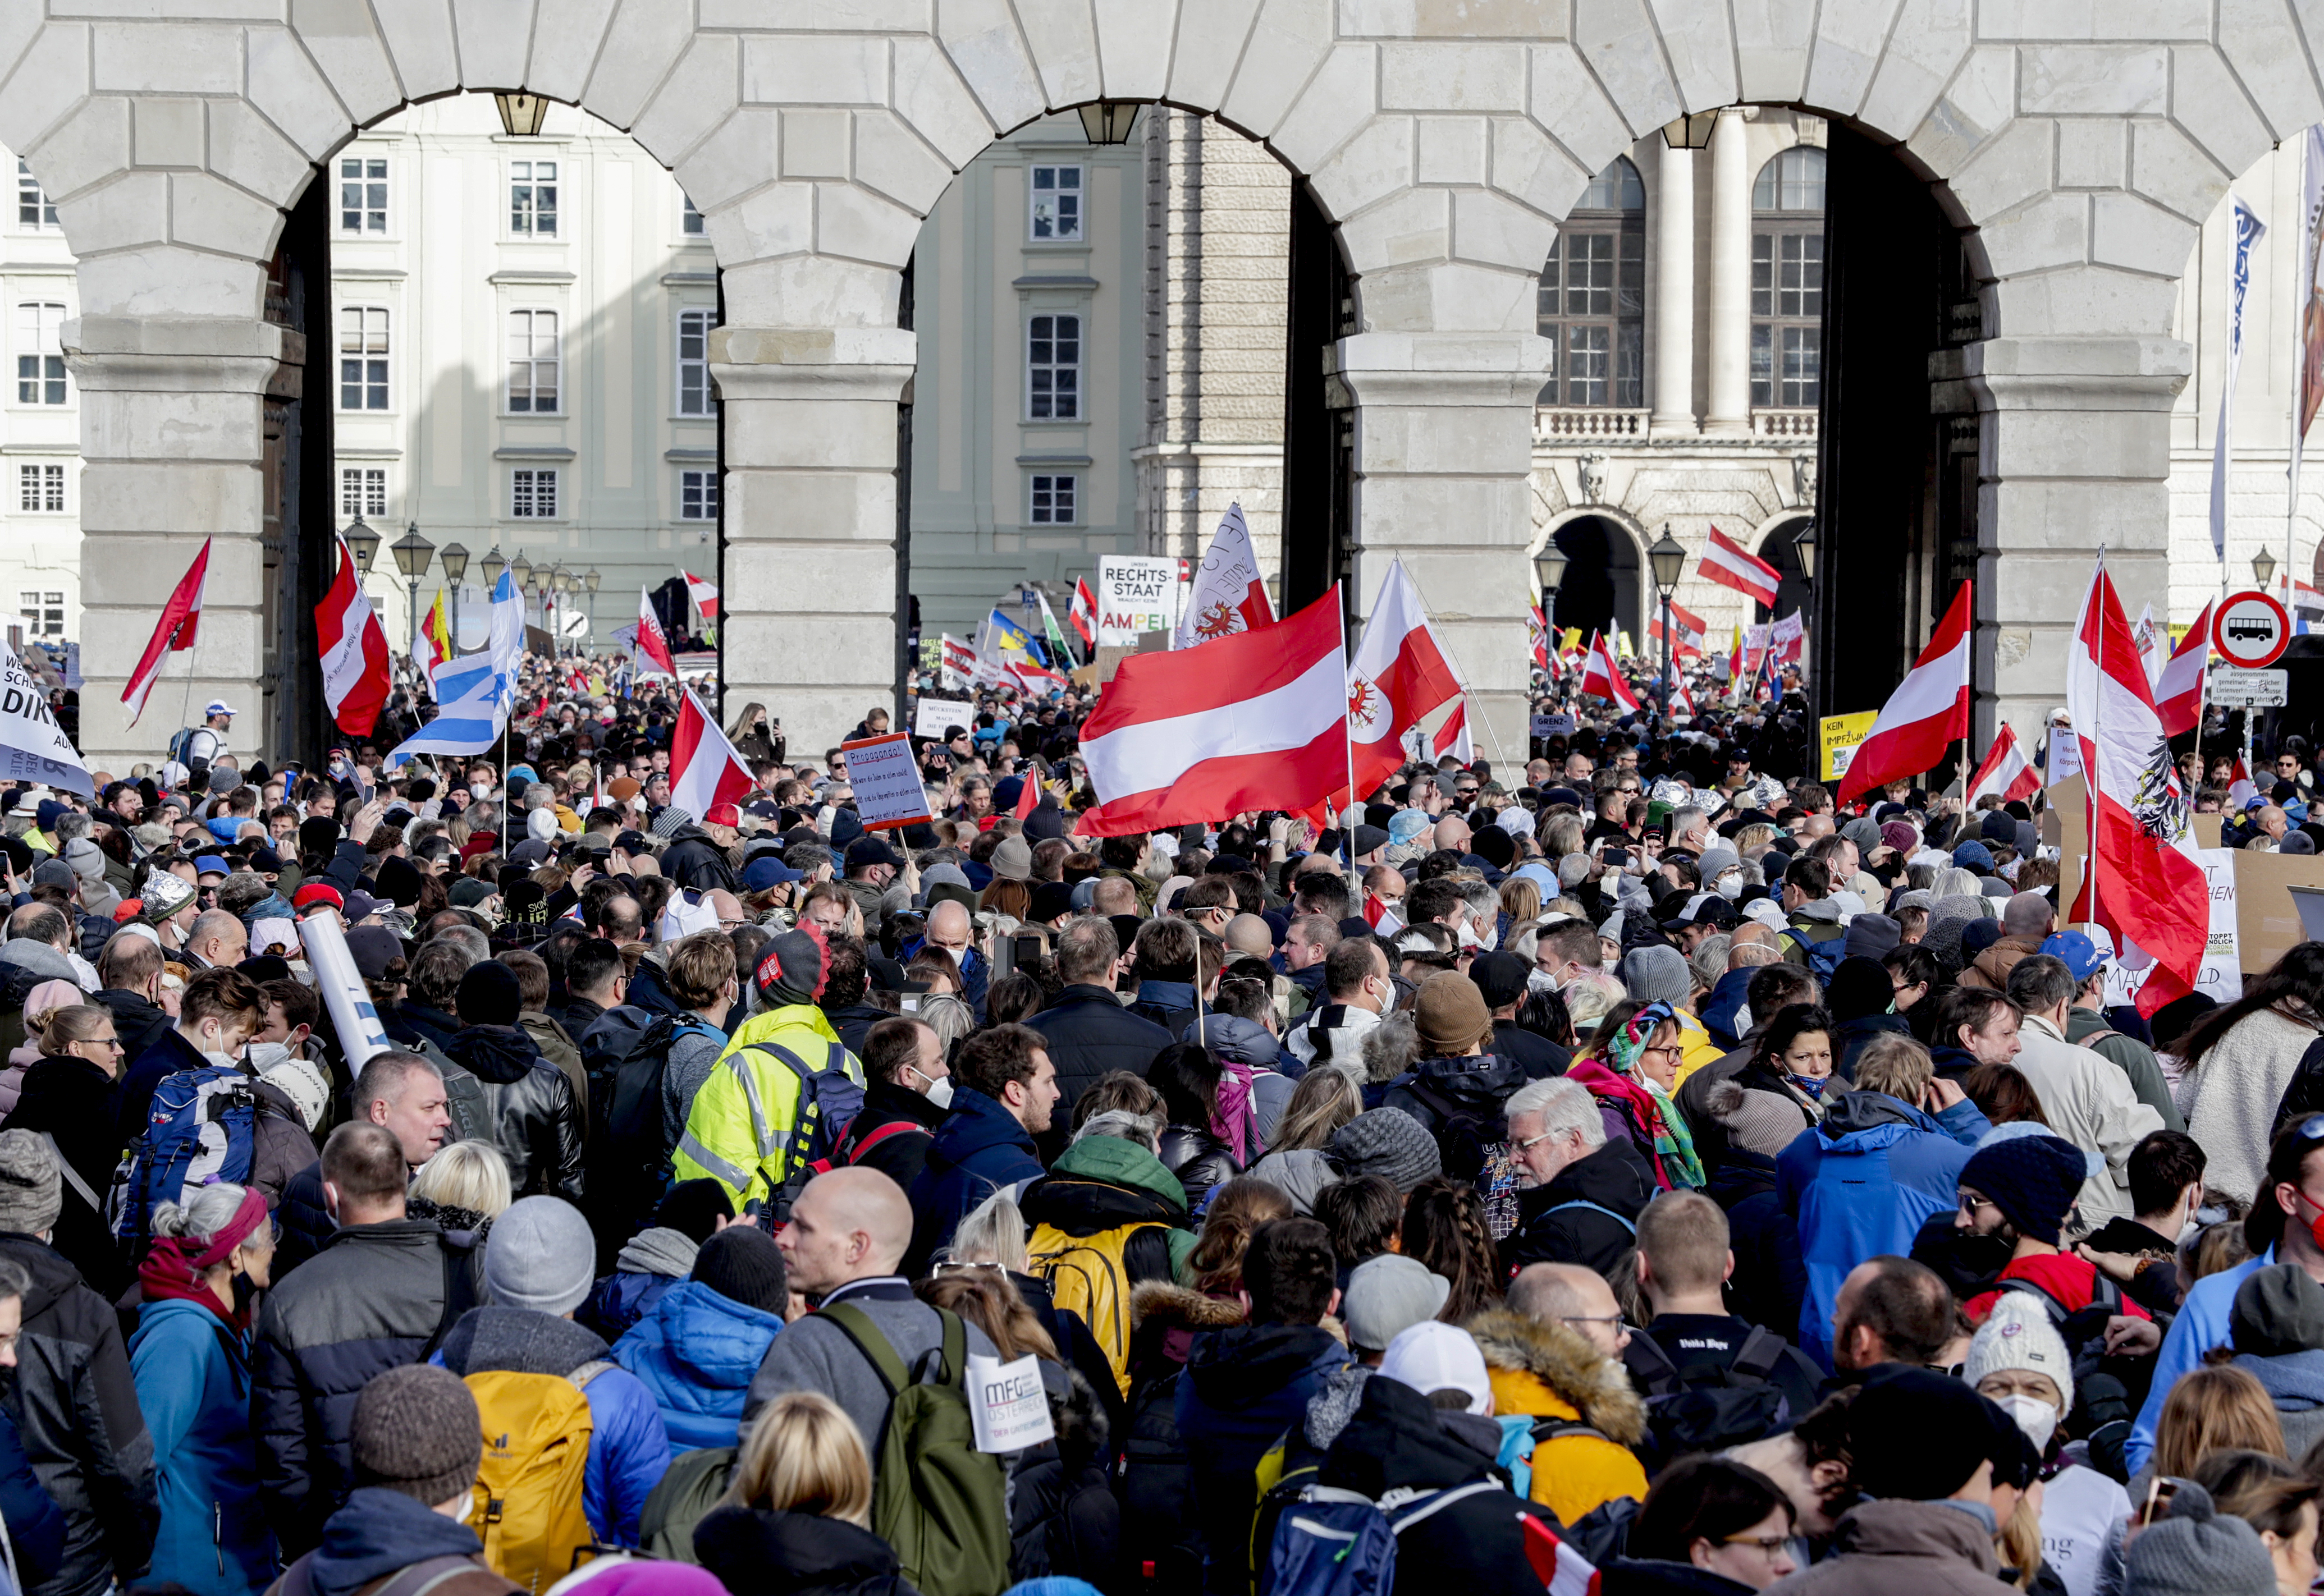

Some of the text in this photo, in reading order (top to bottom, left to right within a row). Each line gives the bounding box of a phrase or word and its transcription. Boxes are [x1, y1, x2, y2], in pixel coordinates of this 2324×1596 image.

[1106, 568, 1173, 583] RECHTS-
[1114, 583, 1163, 597] STAAT
[1101, 612, 1172, 630] AMPEL
[1827, 721, 1843, 732] KEIN
[850, 745, 902, 764] Propaganda!
[2059, 758, 2079, 767] Körper,
[986, 1377, 1023, 1405] MFG
